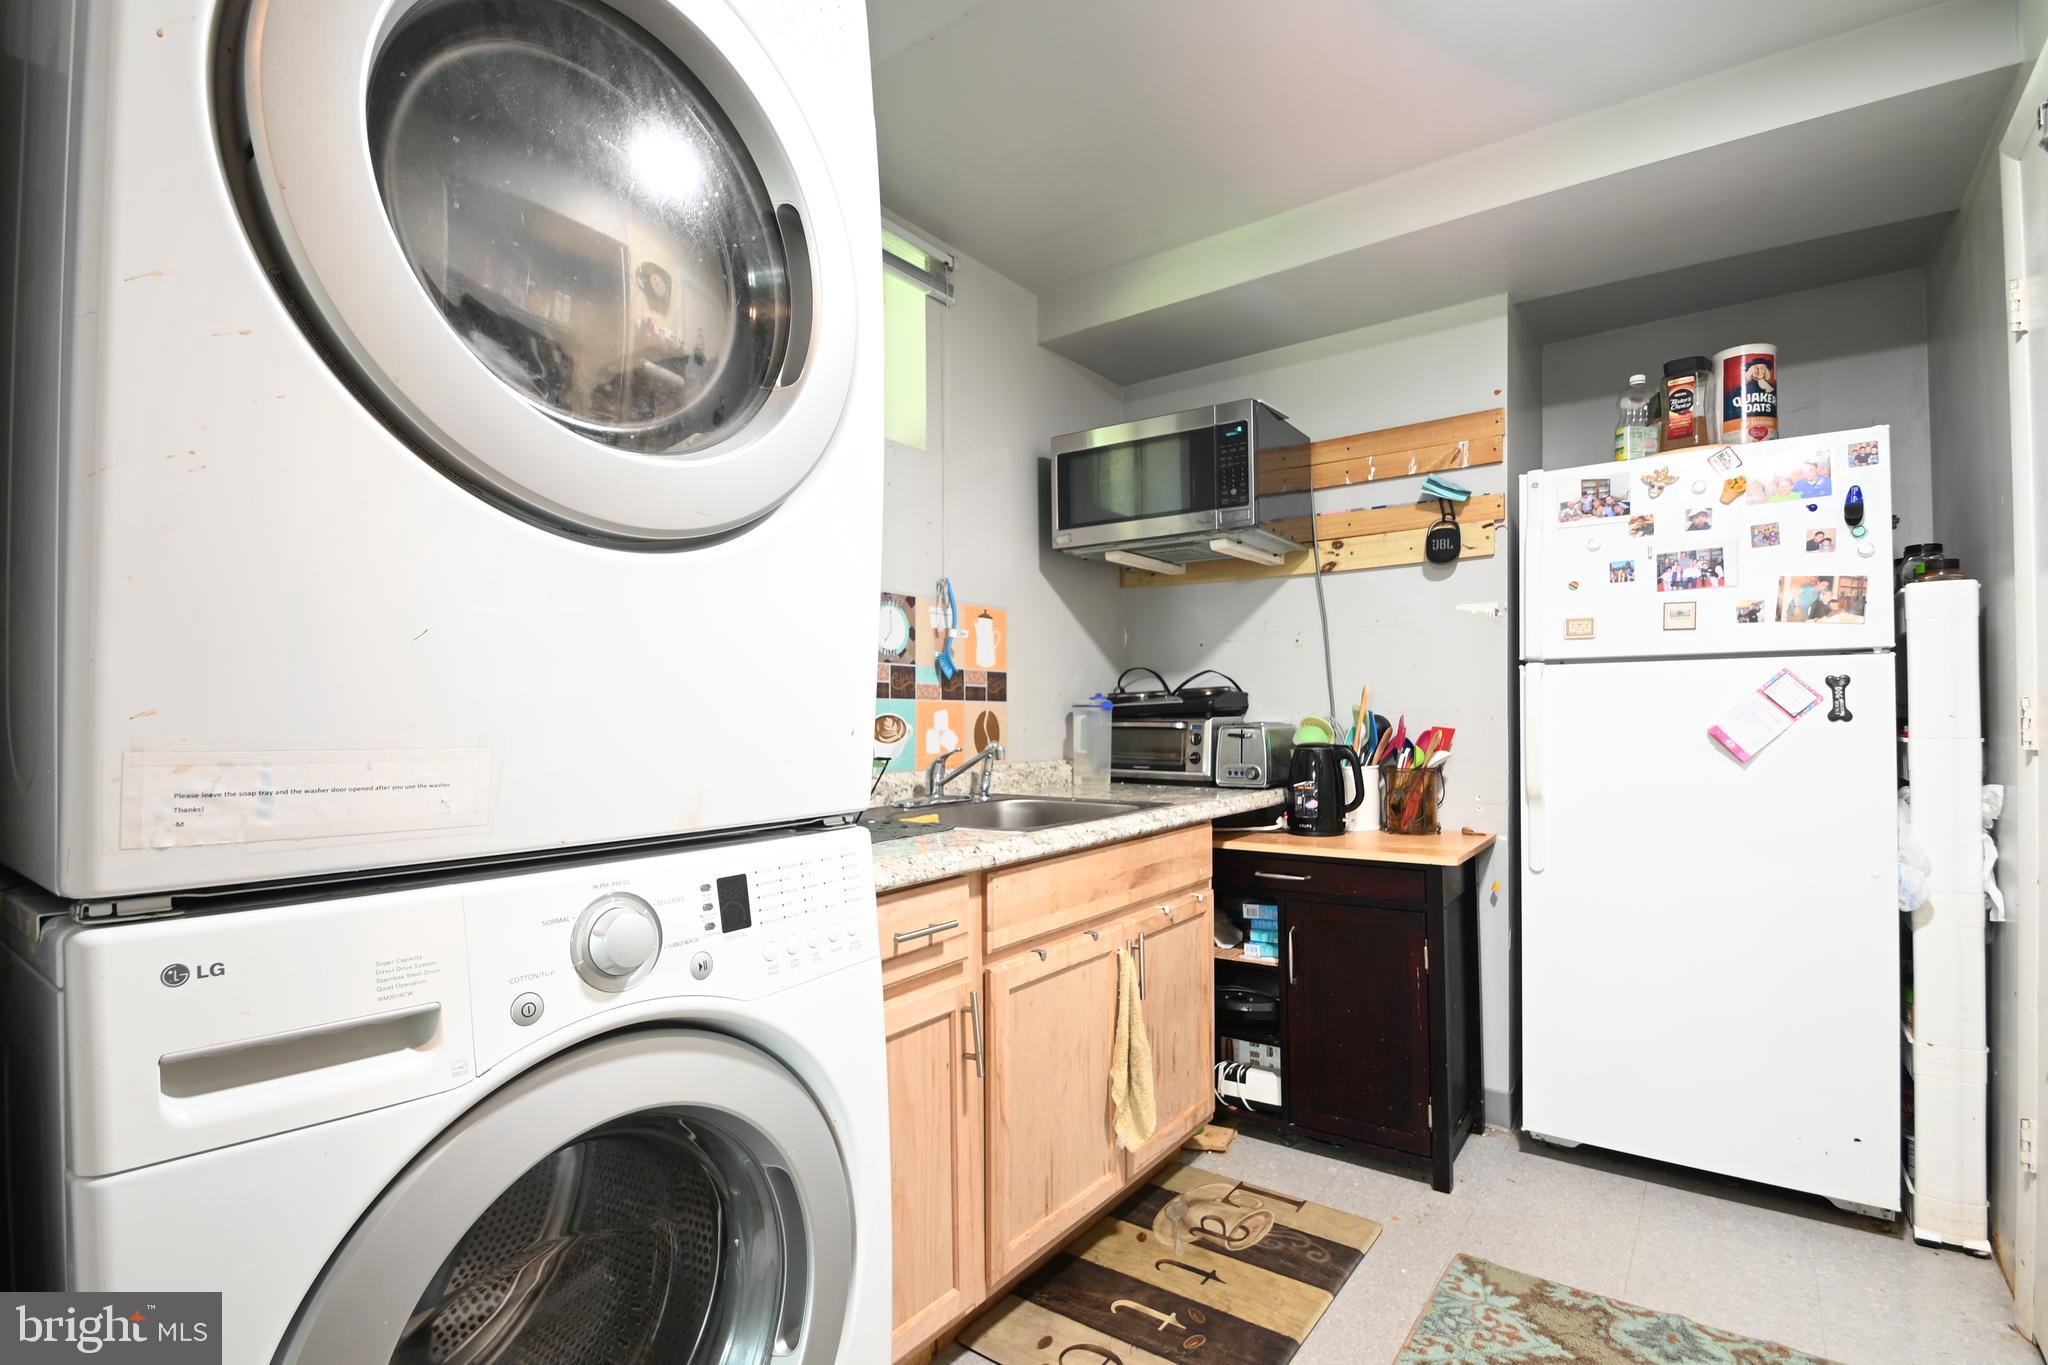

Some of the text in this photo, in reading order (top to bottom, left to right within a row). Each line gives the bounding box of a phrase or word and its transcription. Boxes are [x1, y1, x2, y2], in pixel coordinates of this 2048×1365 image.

[1732, 392, 1777, 408] QUAKER
[1745, 403, 1771, 413] OATS
[1432, 538, 1454, 550] JBL
[174, 806, 204, 814] Thanks!
[656, 896, 685, 906] DELICATES
[542, 917, 570, 927] NORMAL
[667, 937, 700, 949] HAND WASH
[396, 954, 423, 963] Capacity
[414, 960, 437, 968] System
[196, 962, 226, 979] LG
[376, 974, 405, 984] Stainless
[424, 968, 441, 976] Drum
[396, 979, 427, 989] Operation
